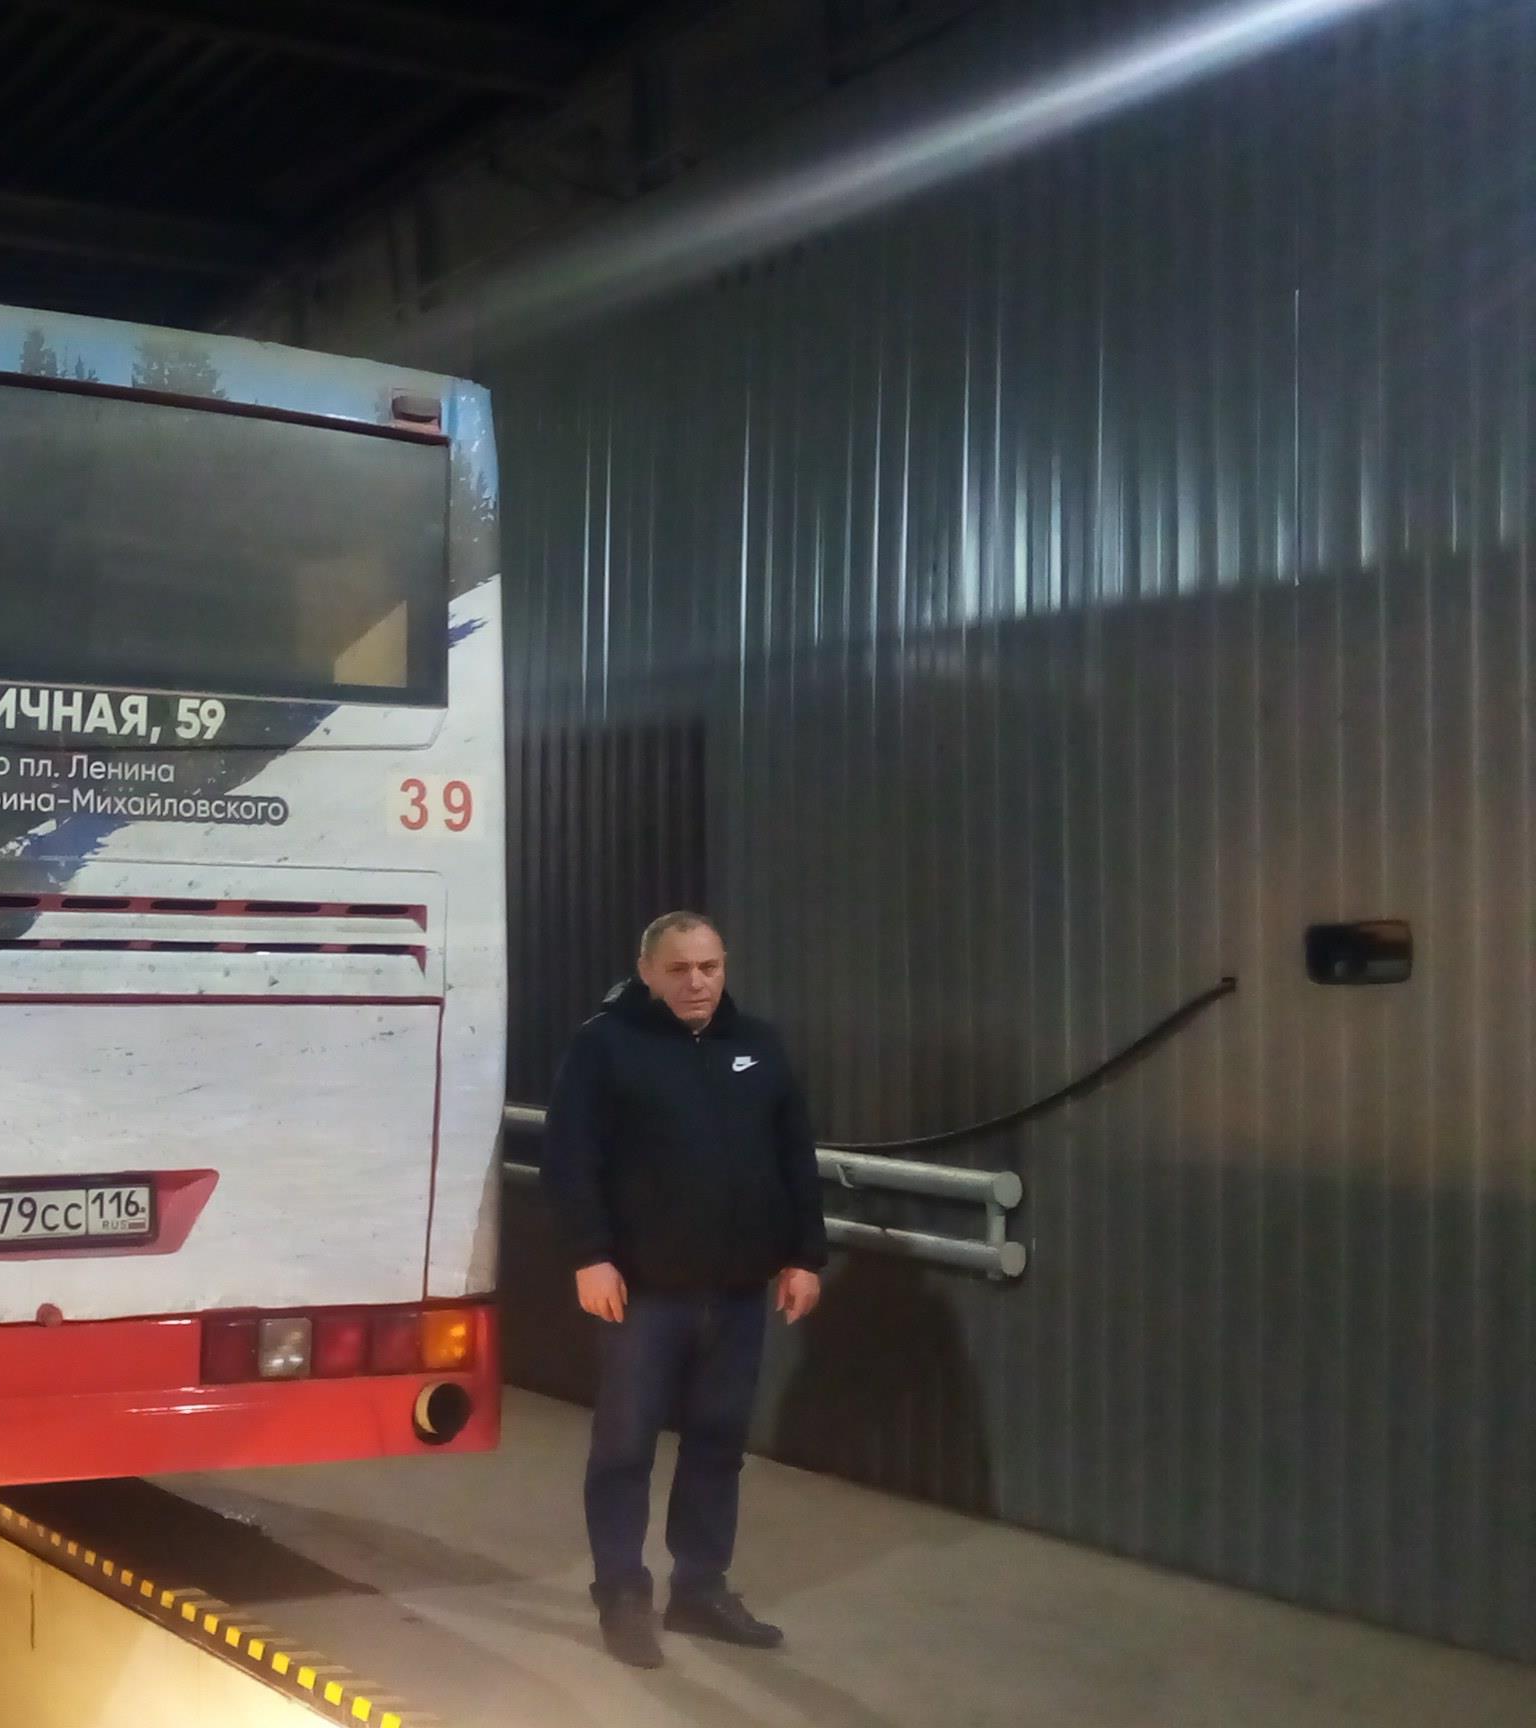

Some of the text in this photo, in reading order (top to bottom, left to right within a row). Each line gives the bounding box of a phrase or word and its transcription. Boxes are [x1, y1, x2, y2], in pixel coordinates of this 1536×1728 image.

[175, 698, 227, 741] 59
[19, 758, 61, 779] пл.
[68, 754, 175, 784] Ленина
[399, 777, 473, 833] 39
[91, 1189, 141, 1219] 116
[101, 1218, 127, 1231] RUS
